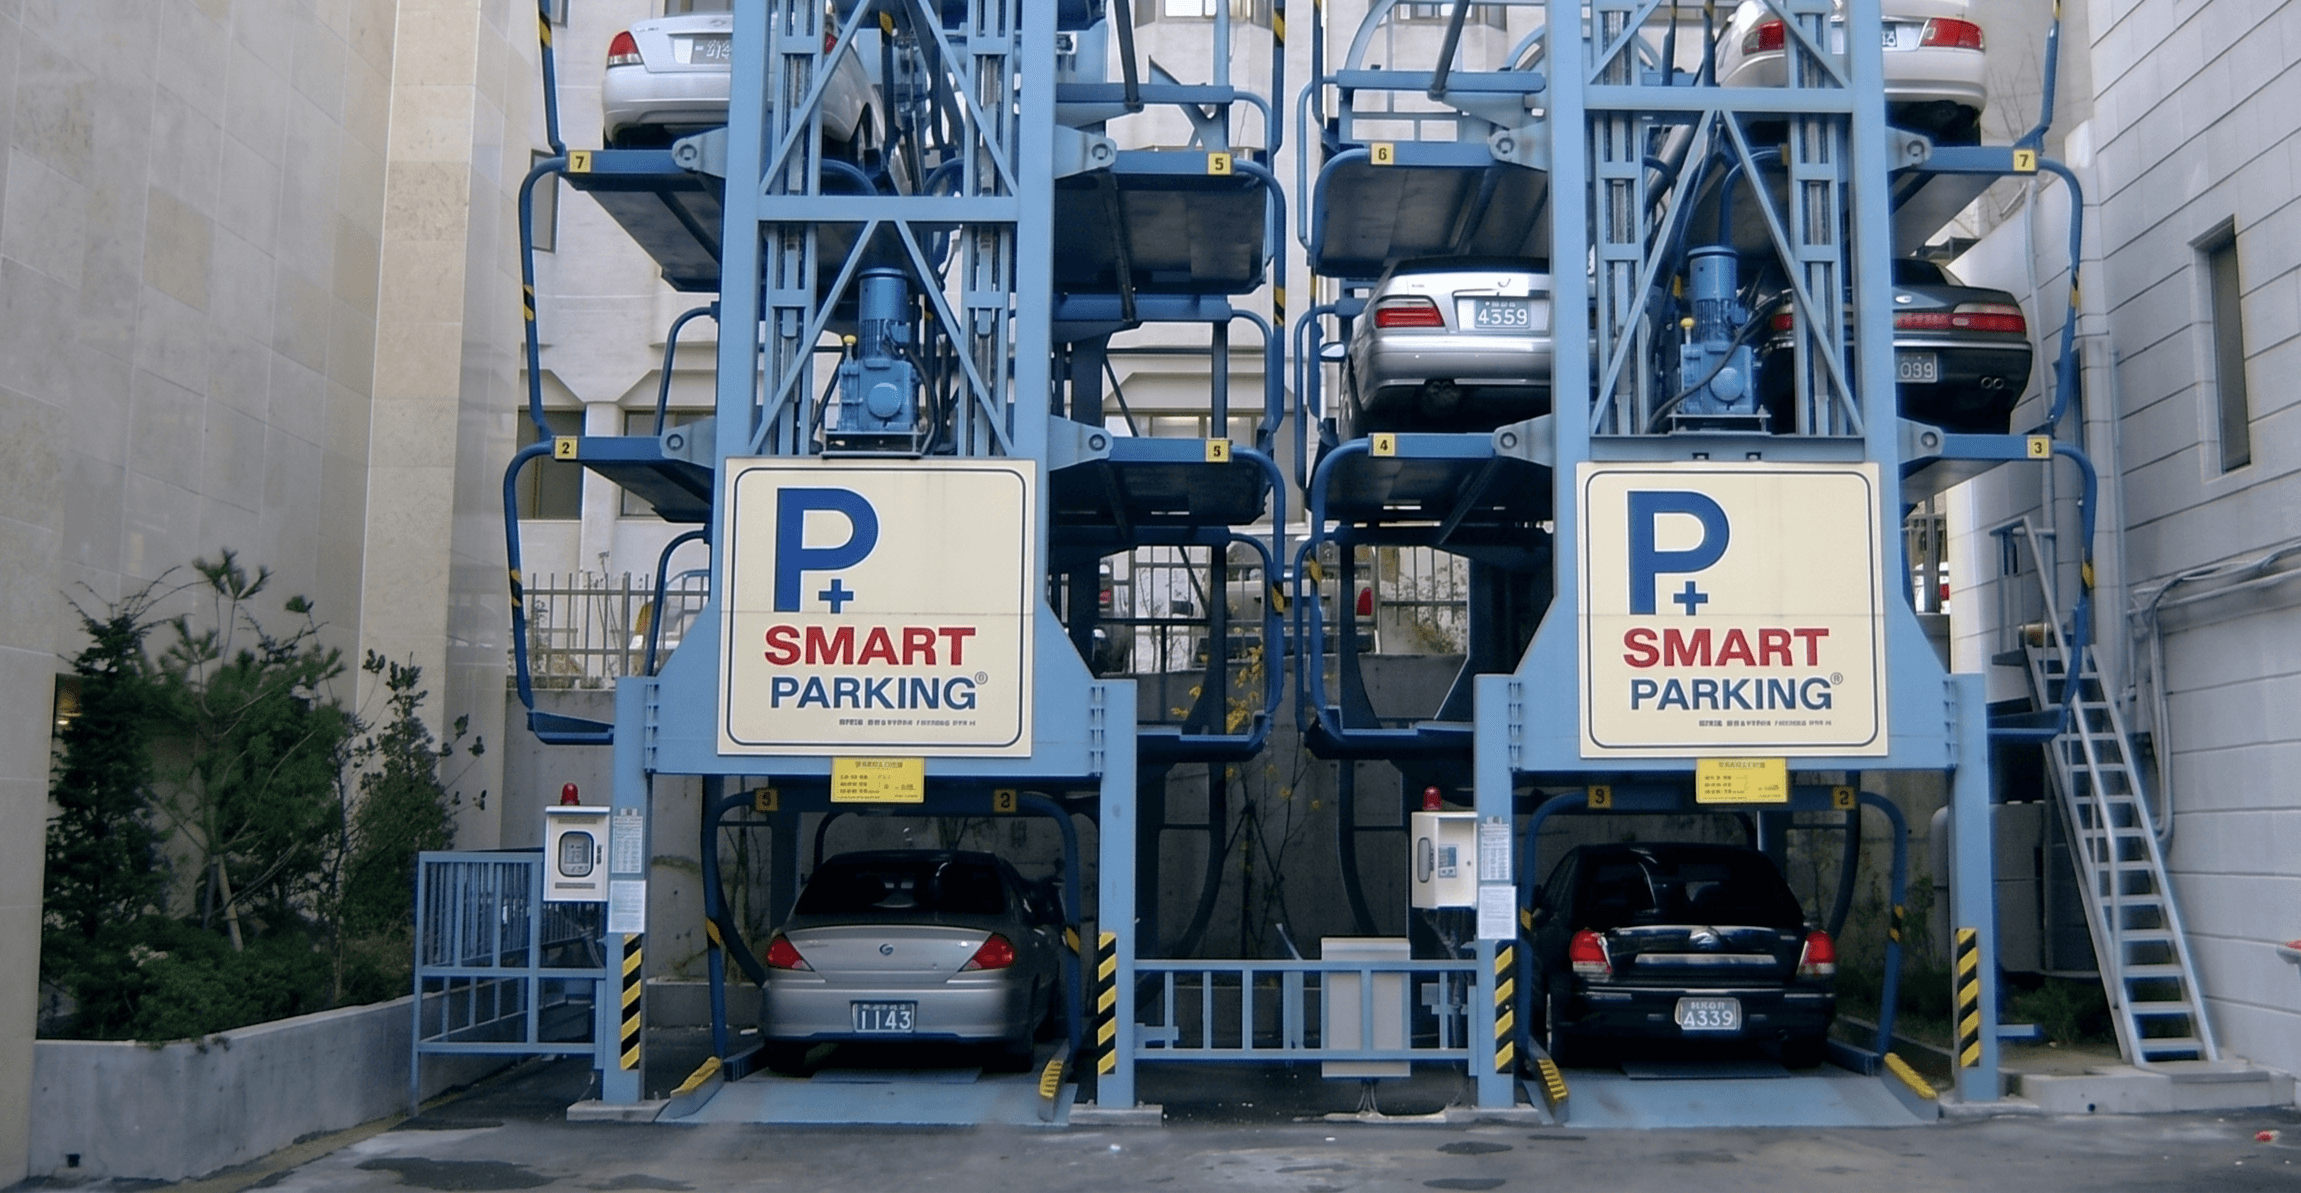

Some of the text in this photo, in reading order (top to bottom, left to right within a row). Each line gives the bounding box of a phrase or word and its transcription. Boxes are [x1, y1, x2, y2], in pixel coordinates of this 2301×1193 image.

[1378, 148, 1387, 161] 6
[2019, 154, 2029, 167] 7
[575, 155, 585, 169] 7
[1214, 157, 1224, 171] 5
[1477, 308, 1528, 325] 4359
[562, 442, 570, 454] 2
[1213, 445, 1221, 457] 5
[1380, 439, 1388, 451] 4
[2034, 442, 2043, 454] 3
[764, 625, 977, 667] SMART
[1623, 627, 1830, 668] SMART
[1000, 792, 1011, 808] 2
[1839, 790, 1849, 805] 2
[861, 1010, 912, 1030] 1143
